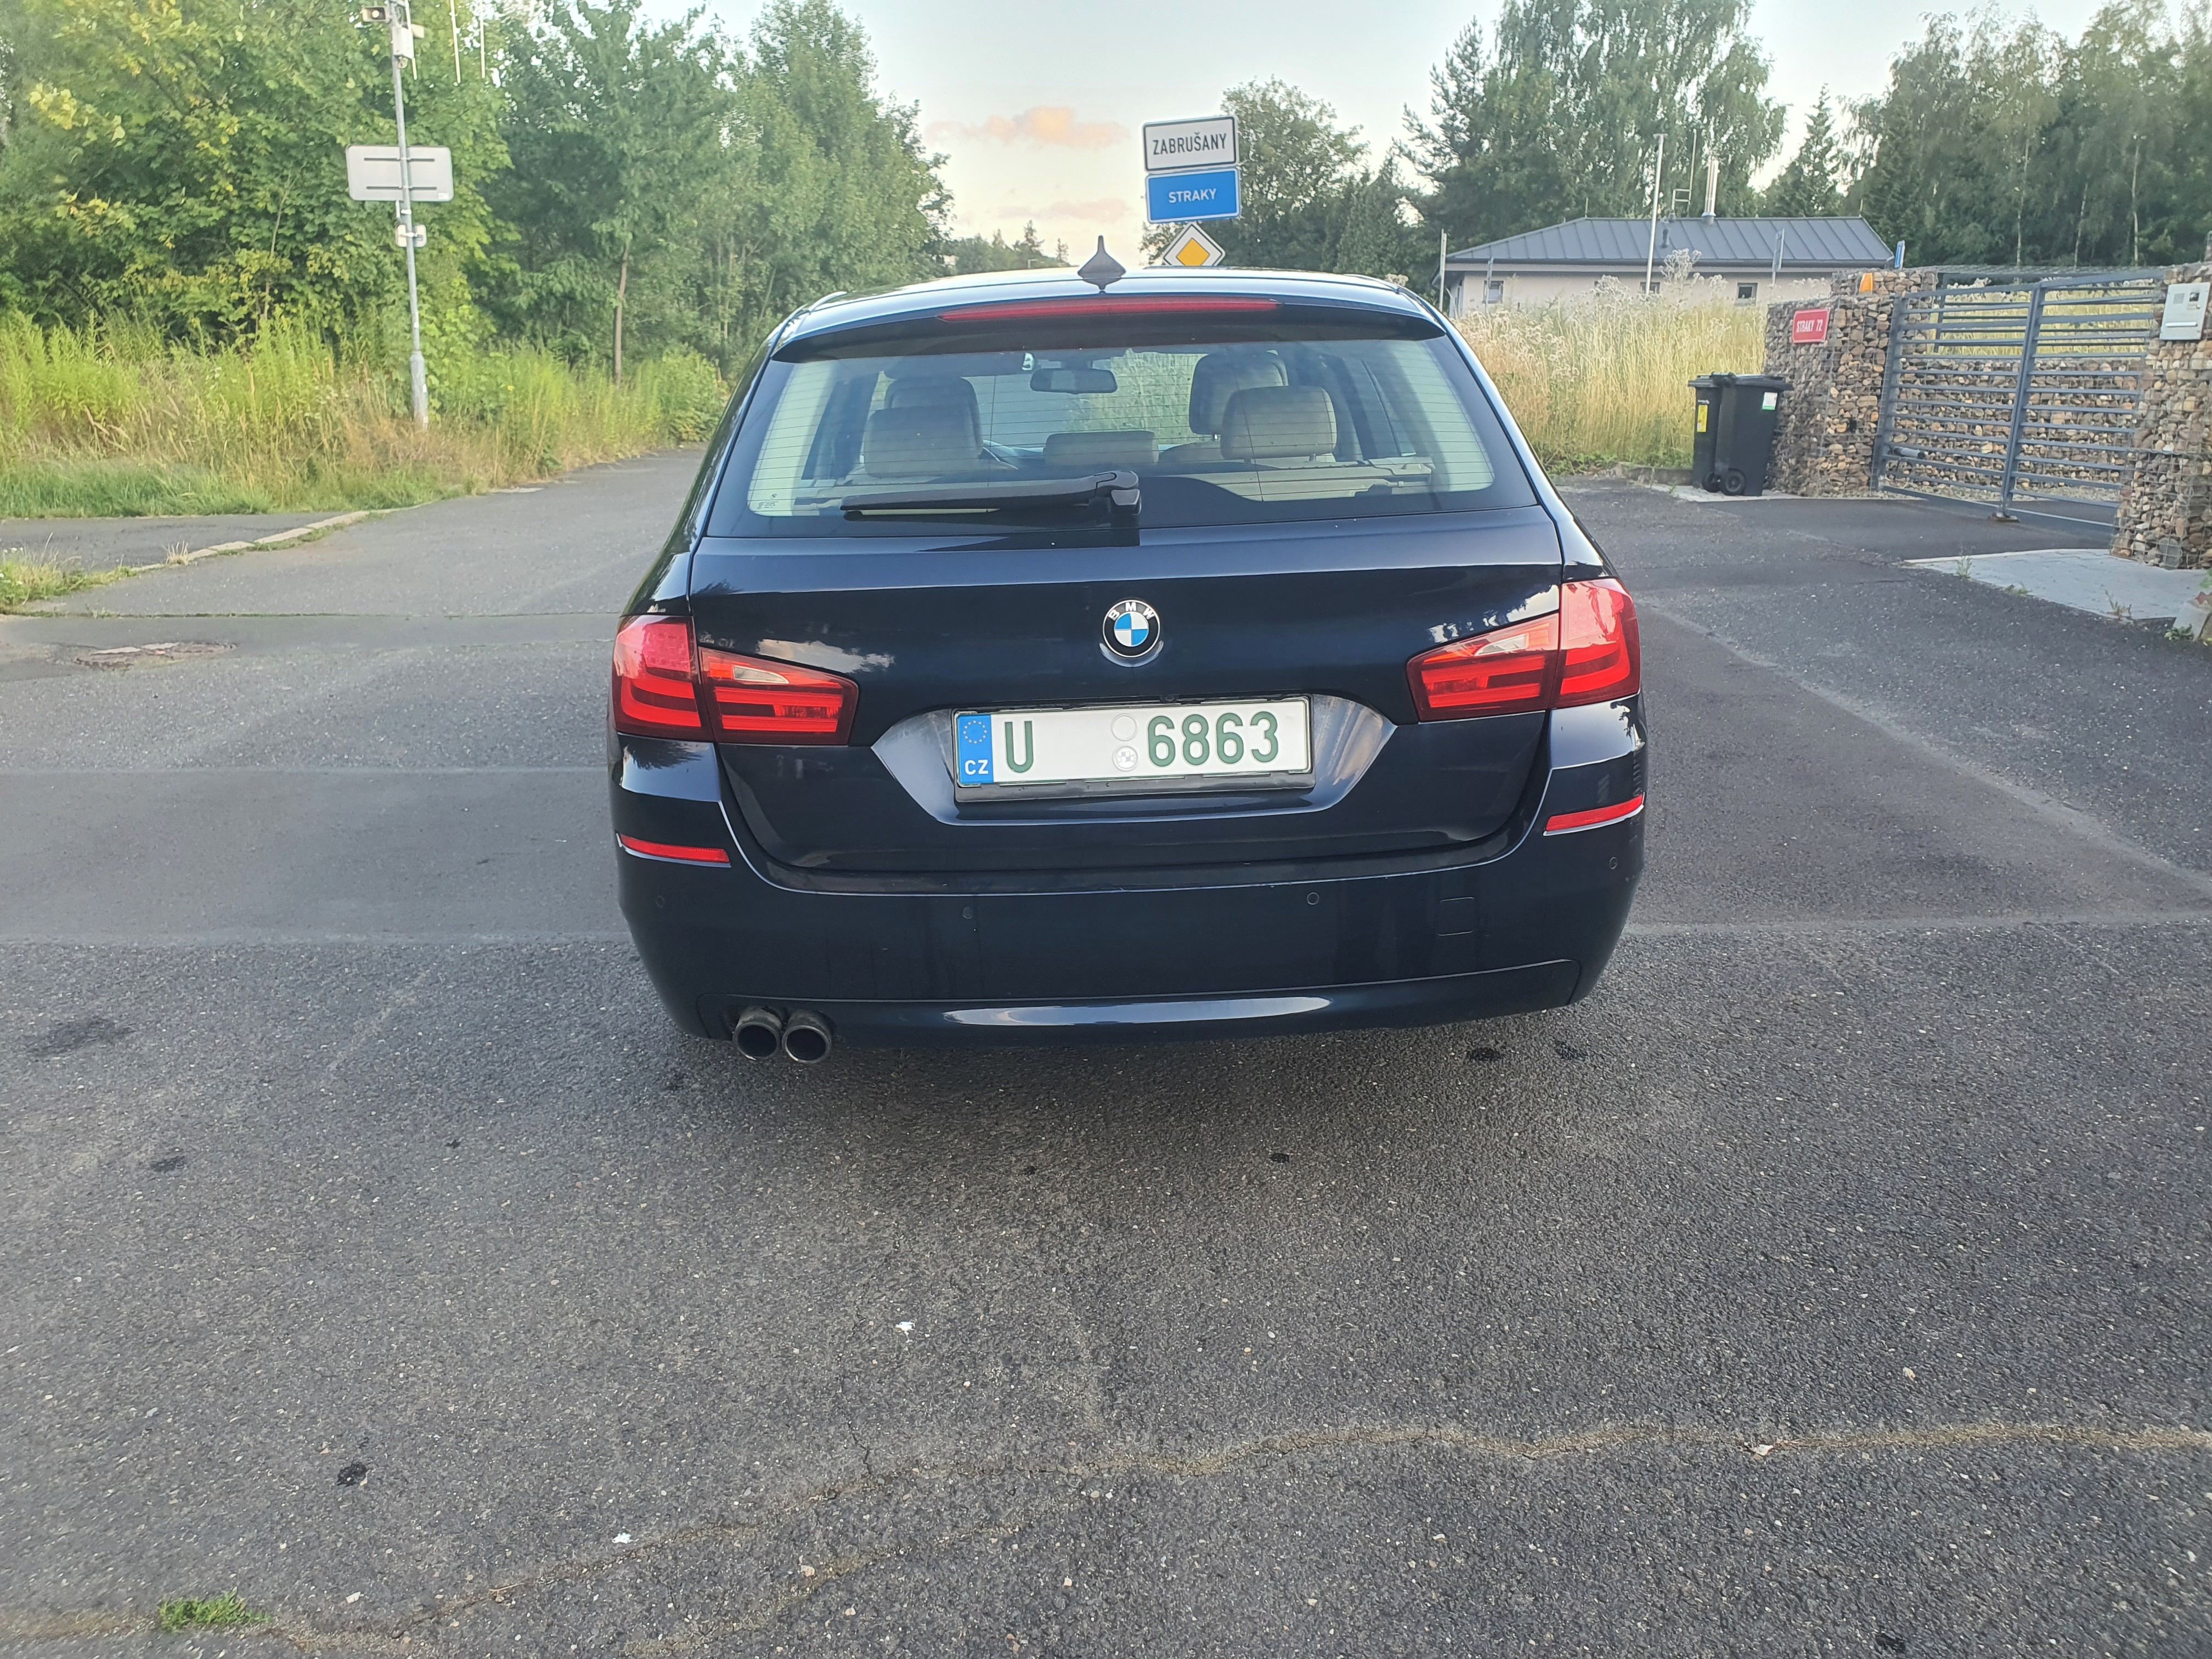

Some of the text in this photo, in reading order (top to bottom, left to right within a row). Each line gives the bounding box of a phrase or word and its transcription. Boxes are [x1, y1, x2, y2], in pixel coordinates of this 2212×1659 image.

[1153, 132, 1227, 155] ZABRUŠANY
[1168, 188, 1217, 204] STRAKY
[1108, 602, 1155, 621] BMW
[1005, 711, 1279, 773] U 6863
[964, 759, 989, 775] CZ
